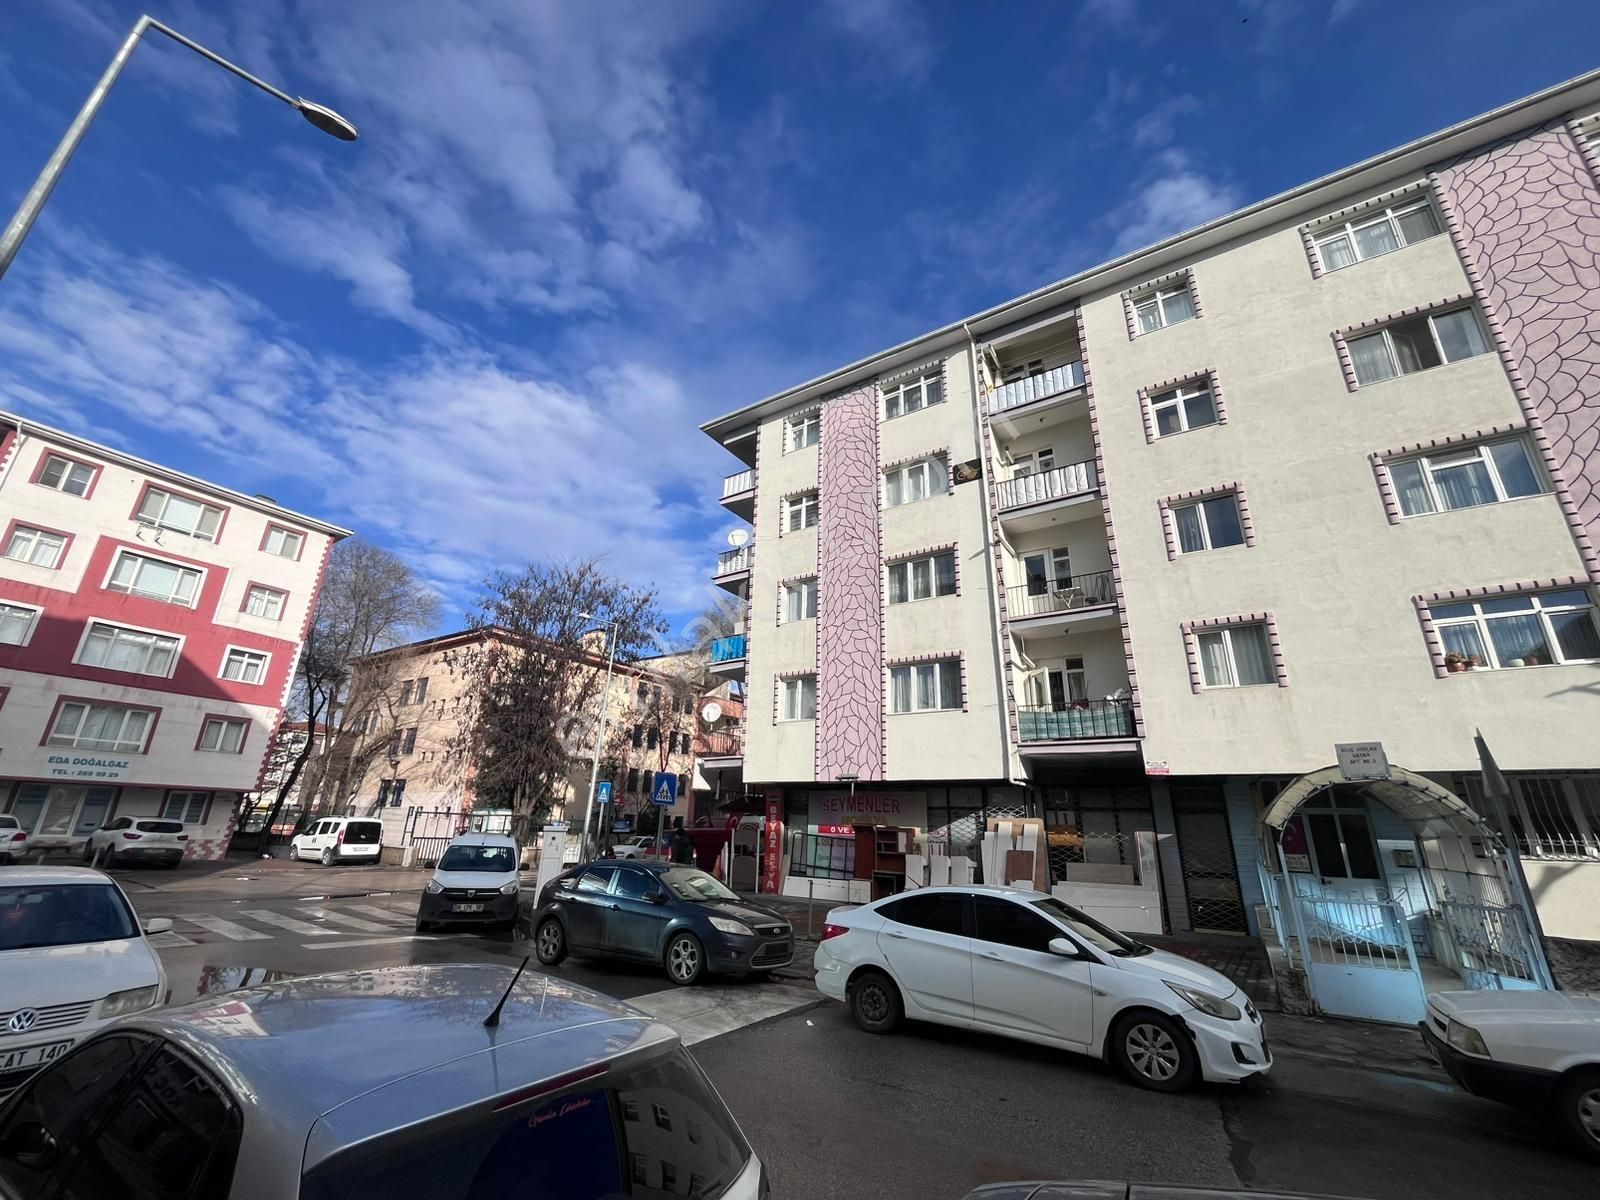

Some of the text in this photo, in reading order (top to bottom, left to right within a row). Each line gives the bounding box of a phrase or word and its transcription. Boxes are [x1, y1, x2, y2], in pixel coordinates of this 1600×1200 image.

[48, 756, 128, 768] EDA DOĞALGAZ
[52, 768, 69, 776] TEL
[823, 794, 901, 814] SEYMENLER
[769, 805, 777, 848] BEYAZ
